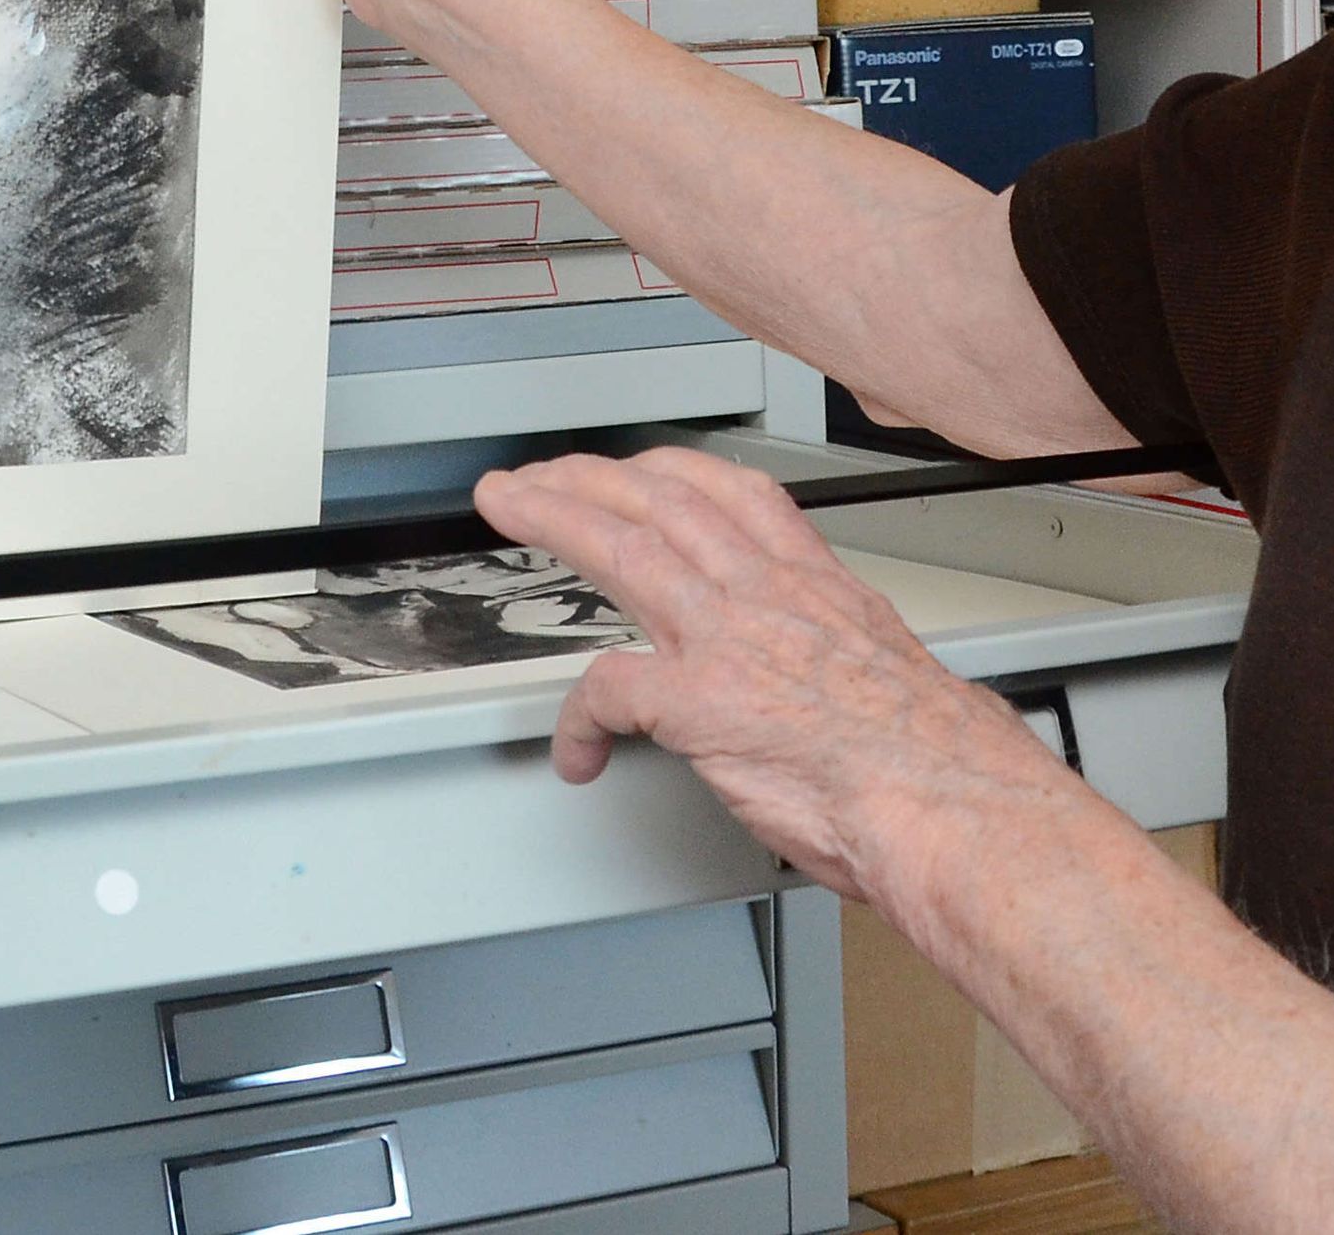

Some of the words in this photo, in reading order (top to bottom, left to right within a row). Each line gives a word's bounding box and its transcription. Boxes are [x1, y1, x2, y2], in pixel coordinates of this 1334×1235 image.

[855, 46, 941, 67] Panasonic
[991, 42, 1053, 60] DMC-TZ1
[856, 77, 917, 105] TZ1
